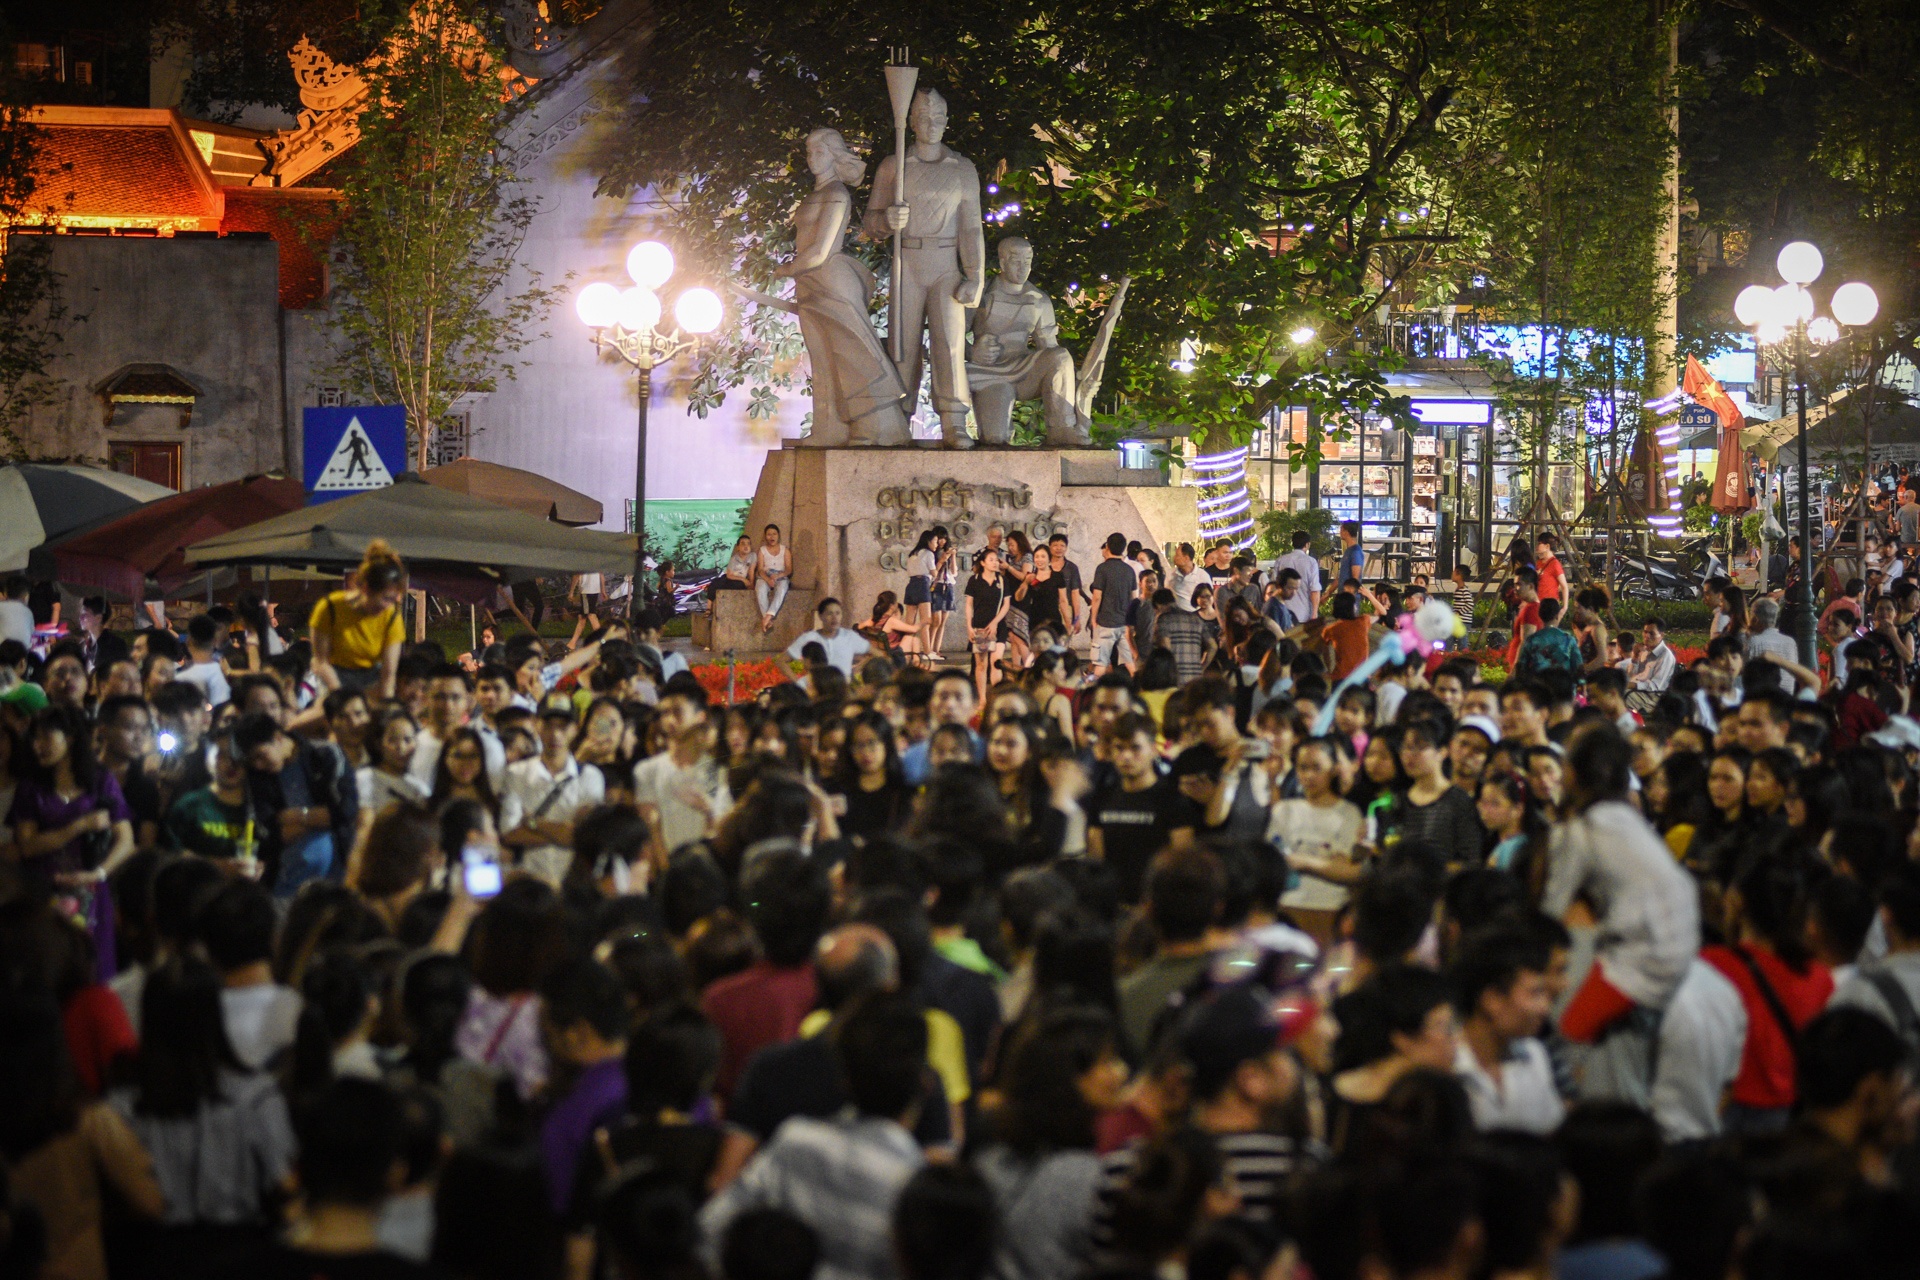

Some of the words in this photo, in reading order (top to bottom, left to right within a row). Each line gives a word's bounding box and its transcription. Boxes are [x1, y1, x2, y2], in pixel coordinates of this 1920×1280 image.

[1680, 414, 1694, 424] LÒ
[1696, 413, 1711, 424] SŨ
[877, 478, 970, 509] QUYẾT
[879, 551, 972, 572] QUT
